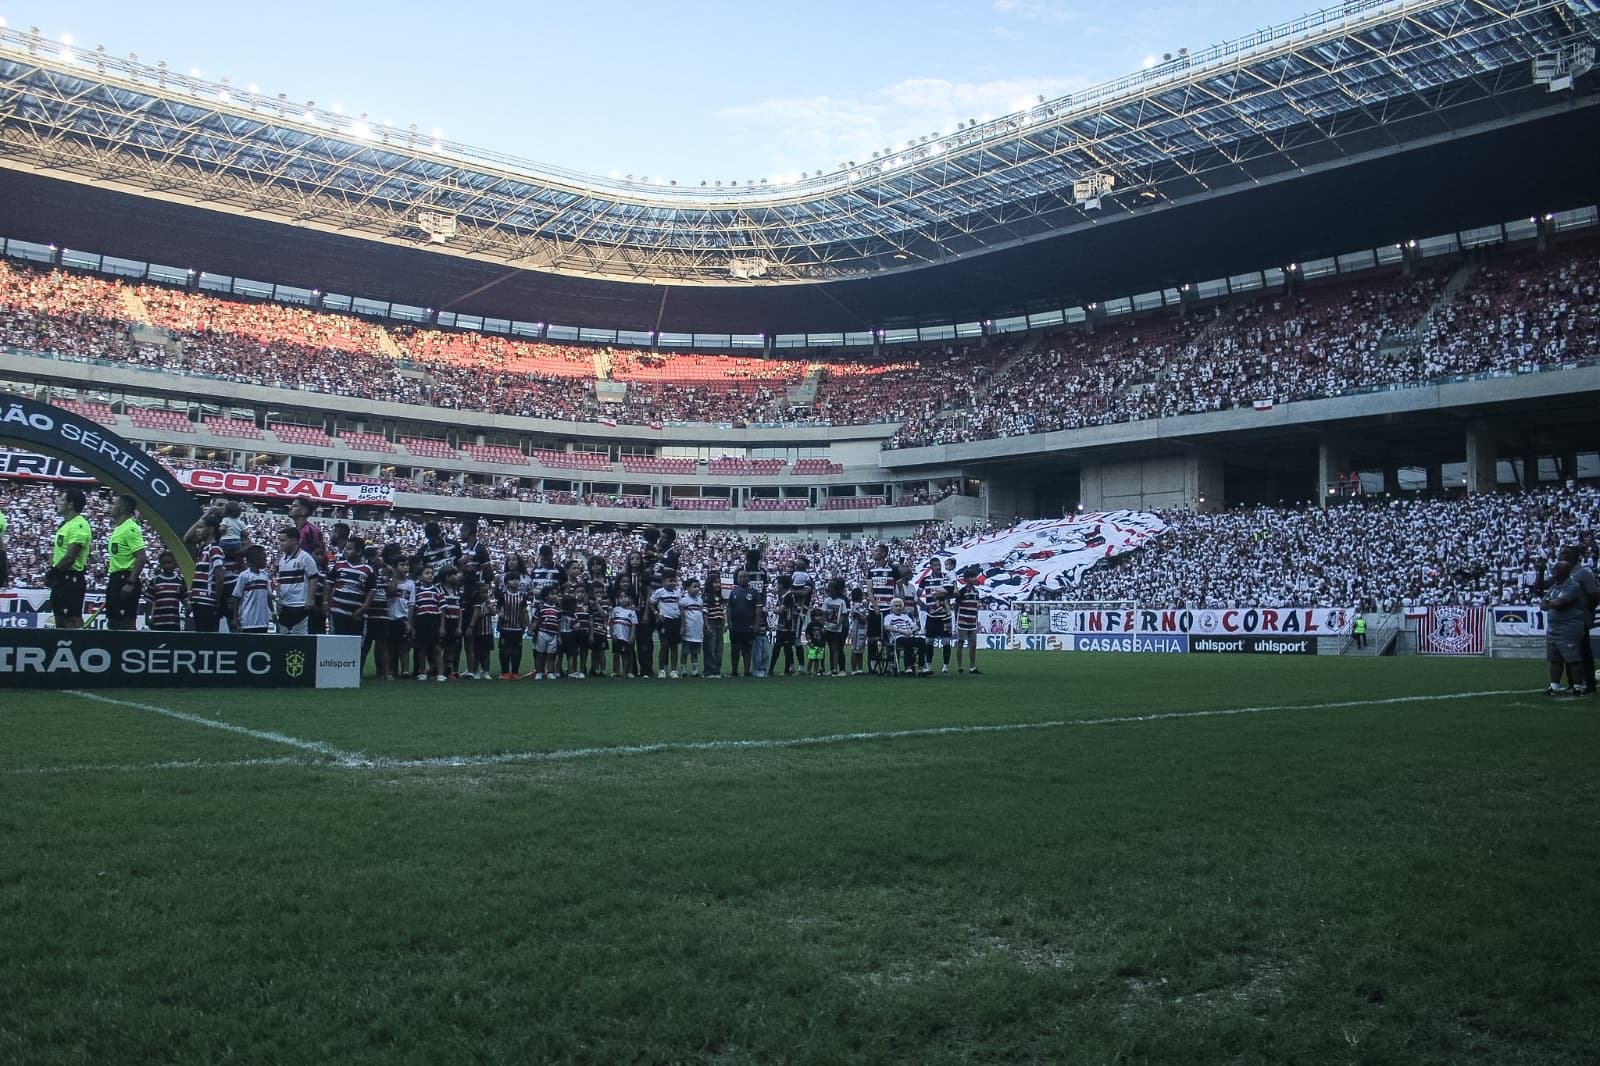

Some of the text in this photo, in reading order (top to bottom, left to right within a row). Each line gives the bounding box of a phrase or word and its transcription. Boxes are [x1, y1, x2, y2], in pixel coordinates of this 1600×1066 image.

[0, 403, 170, 497] ÃO SÉRIE C
[190, 470, 348, 501] CORAL
[361, 486, 379, 494] Bet
[0, 615, 28, 628] rte
[1079, 610, 1194, 633] INFERNO
[1222, 609, 1320, 633] CORAL
[986, 635, 1005, 650] Sil
[1026, 635, 1046, 650] Sil
[1194, 640, 1243, 652] uhlsport
[1254, 640, 1306, 654] uhlsport
[121, 643, 238, 674] SÉRIE
[246, 651, 271, 675] C
[320, 659, 356, 669] uhlsport
